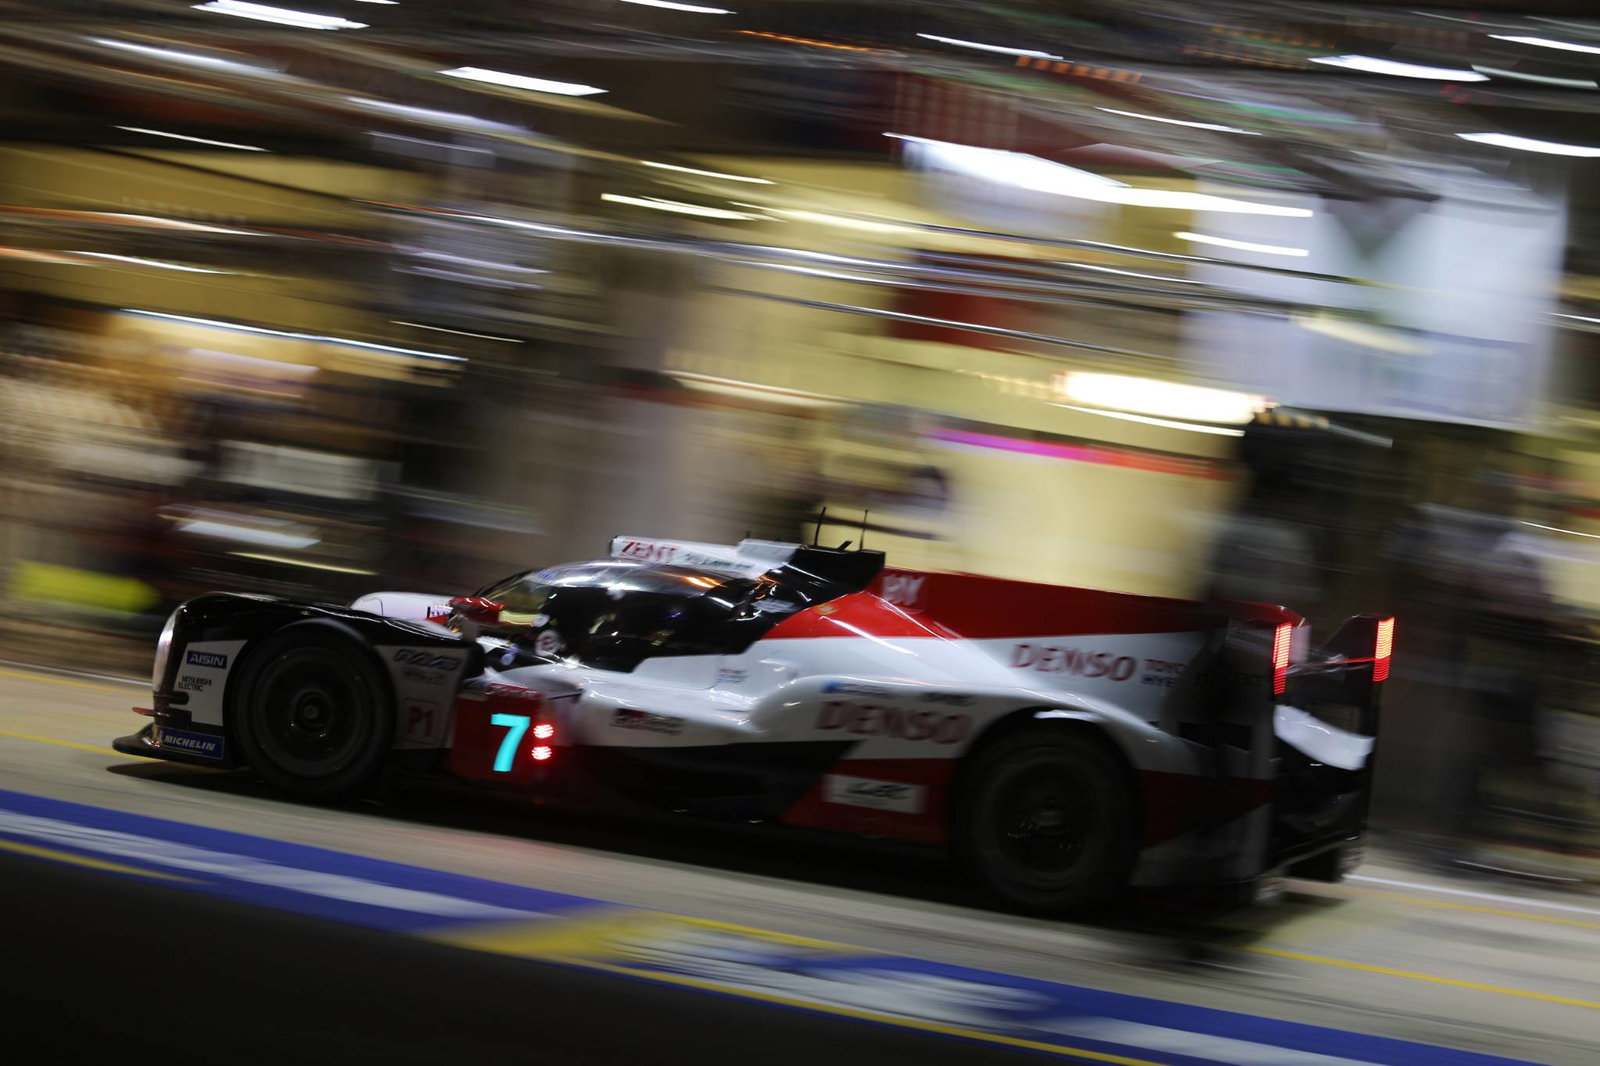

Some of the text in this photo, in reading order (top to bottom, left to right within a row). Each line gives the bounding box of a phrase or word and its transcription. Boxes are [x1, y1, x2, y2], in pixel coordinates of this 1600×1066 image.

[621, 540, 677, 562] ZENT
[190, 653, 224, 667] AISIN
[1010, 643, 1136, 682] DENSO
[178, 682, 204, 692] ELECTRIC
[408, 705, 434, 737] P1
[814, 700, 973, 744] DENSO
[165, 735, 216, 751] MICHELIN
[490, 713, 531, 772] 7
